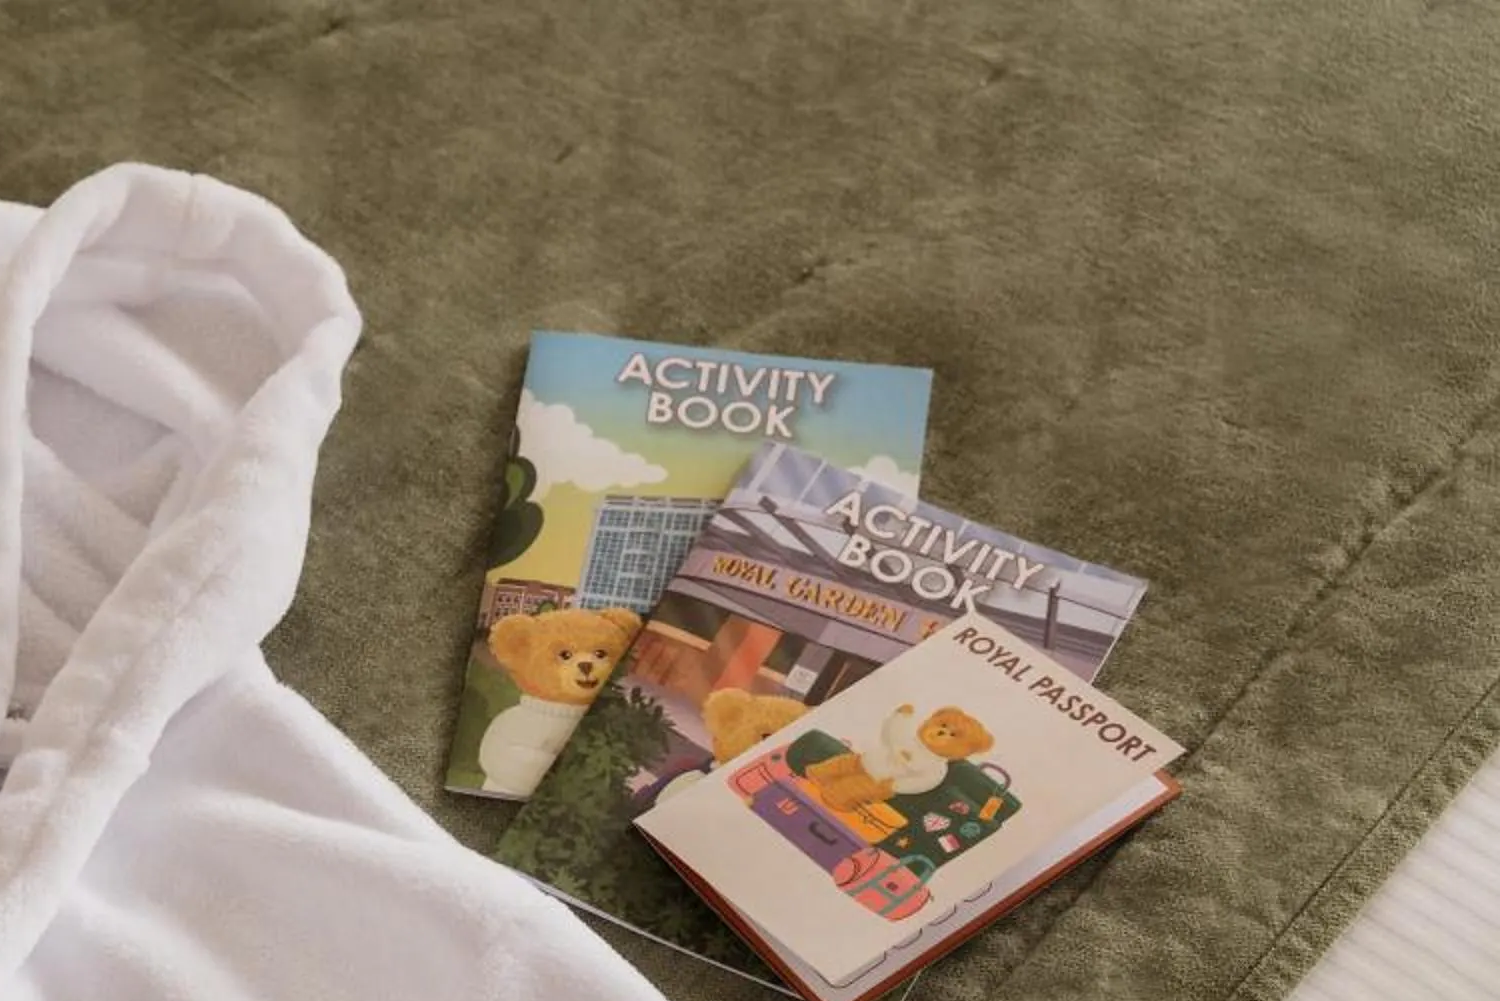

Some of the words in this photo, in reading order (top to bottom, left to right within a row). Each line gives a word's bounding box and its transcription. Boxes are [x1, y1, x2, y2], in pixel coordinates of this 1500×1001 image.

[618, 353, 835, 405] ACTIVITY
[648, 391, 796, 438] BOOK
[825, 491, 1045, 590] ACTIVITY
[837, 533, 992, 613] BOOK
[712, 555, 777, 591] ROYAL
[787, 574, 907, 633] GARDEN
[952, 626, 1033, 683] ROYAL
[1027, 674, 1157, 762] PASSPORT
